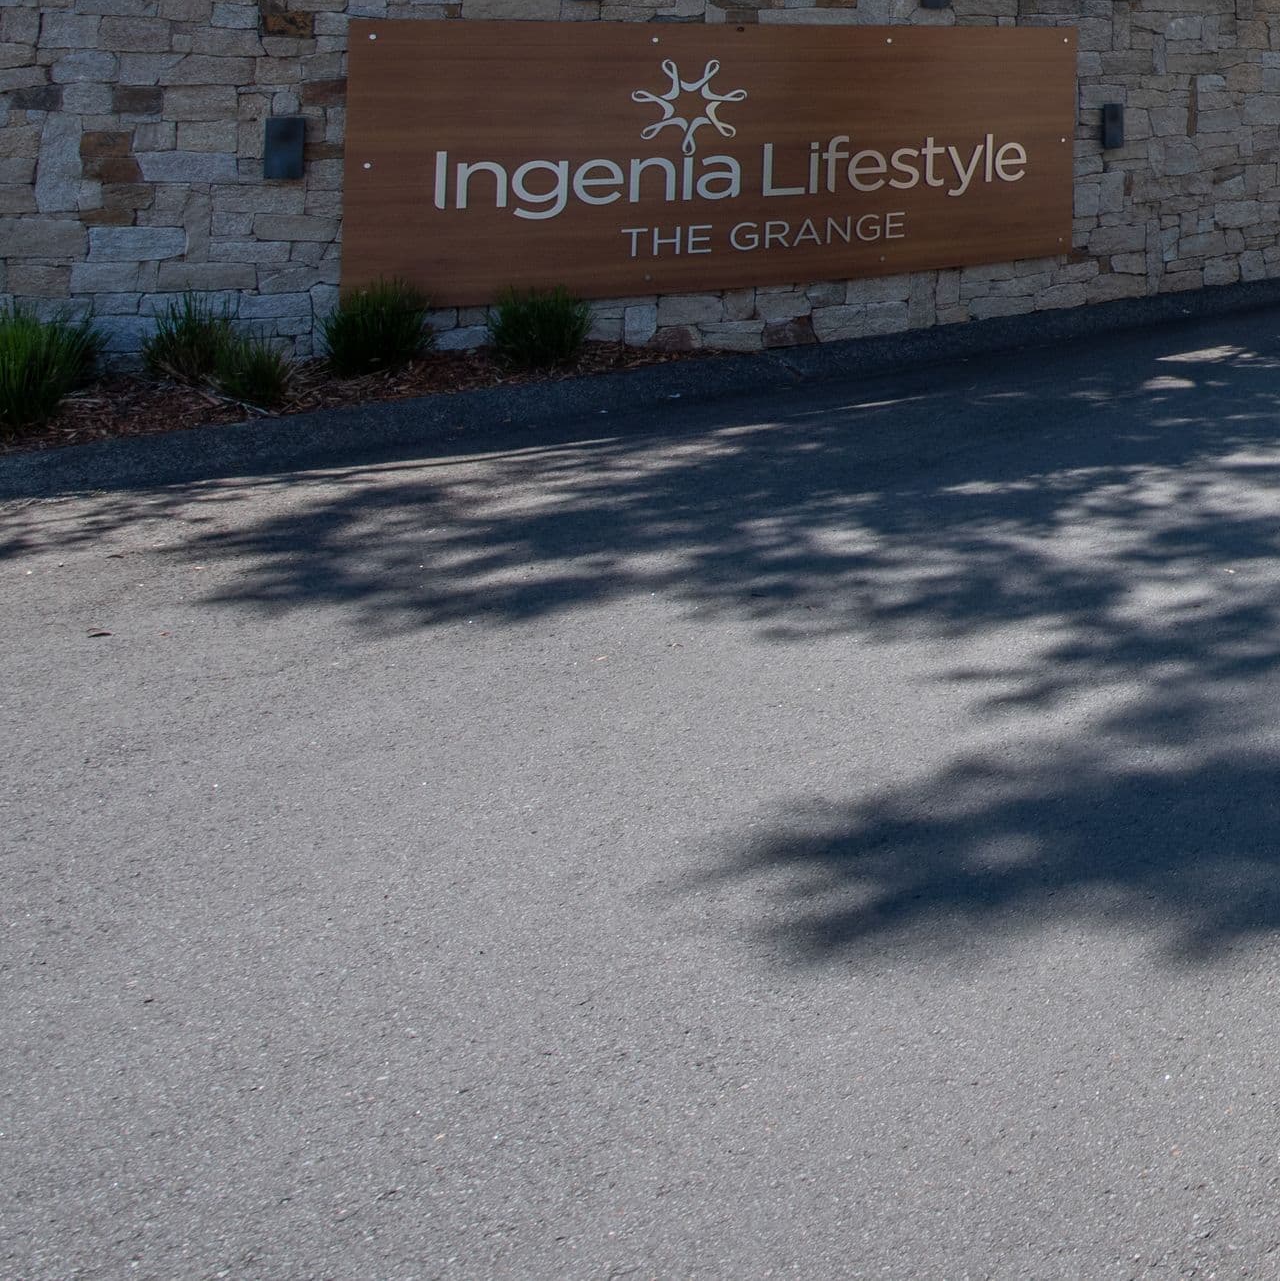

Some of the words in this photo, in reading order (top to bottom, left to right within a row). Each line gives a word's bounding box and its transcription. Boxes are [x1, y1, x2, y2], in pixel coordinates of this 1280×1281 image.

[434, 150, 741, 220] Ingenia
[761, 133, 1028, 197] Lifestyle
[621, 224, 713, 257] THE
[730, 212, 906, 251] GRANGE
